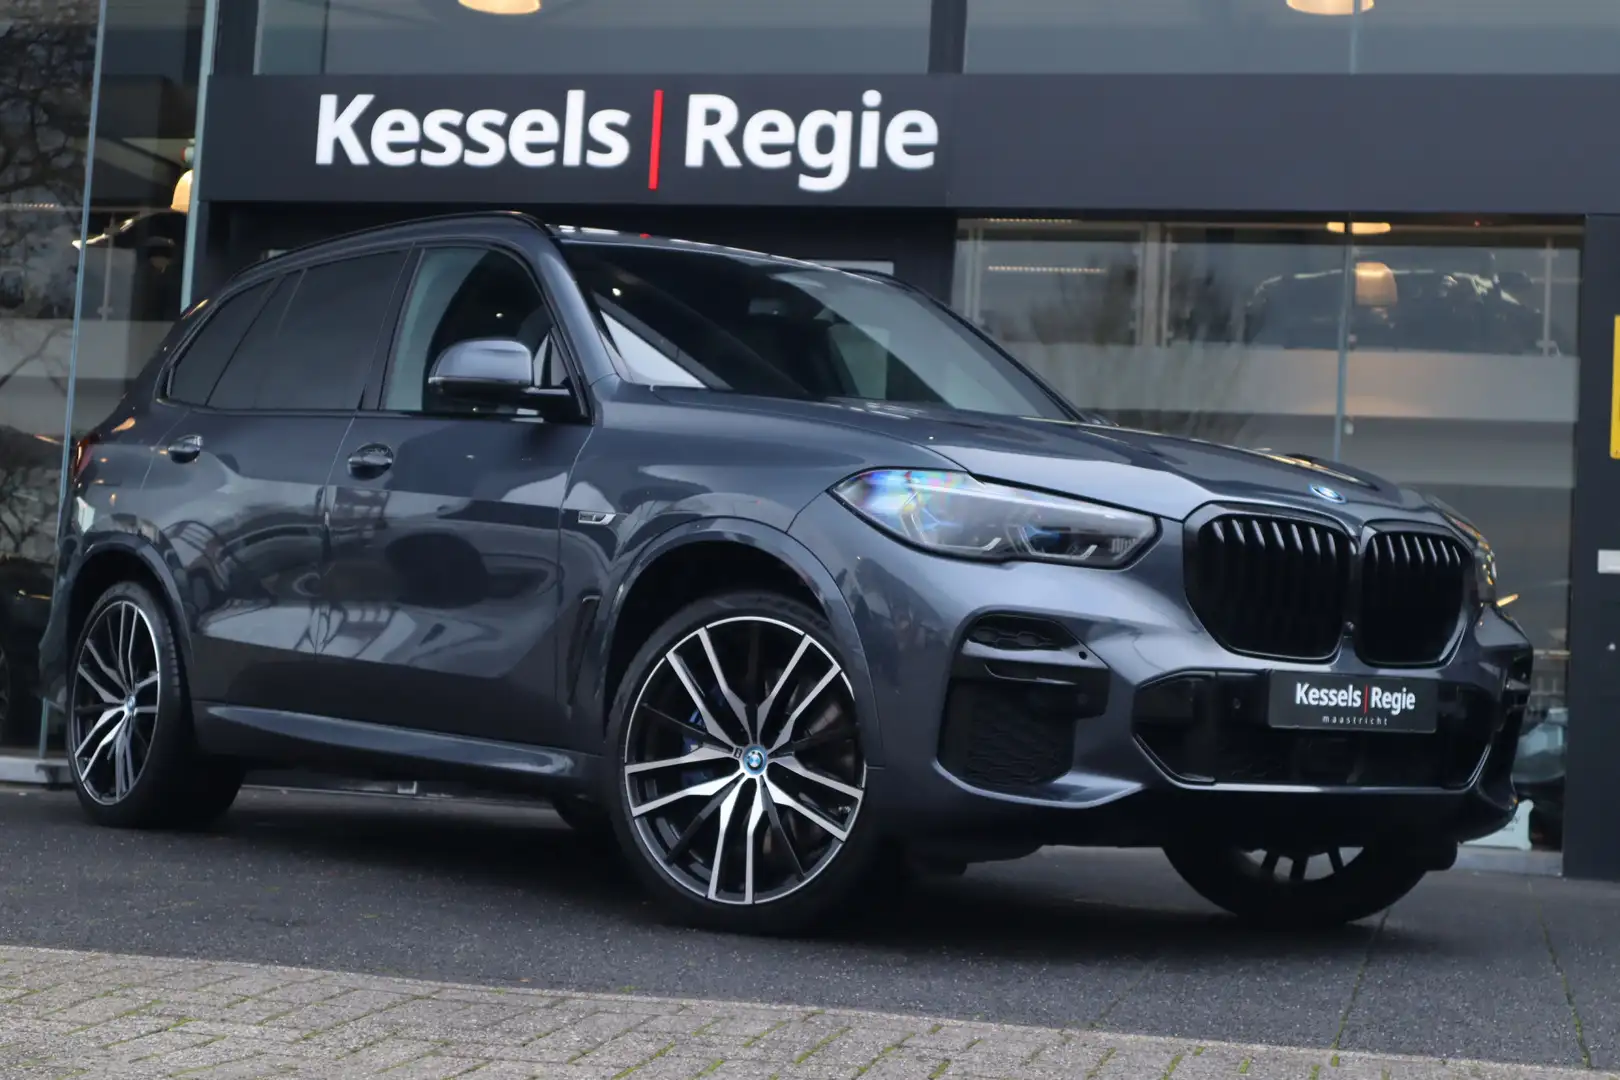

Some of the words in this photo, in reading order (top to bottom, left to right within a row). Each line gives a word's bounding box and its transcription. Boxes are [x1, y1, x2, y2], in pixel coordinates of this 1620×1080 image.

[315, 89, 631, 168] Kessels
[684, 89, 939, 192] Regie
[1295, 682, 1362, 707] Kessels
[1370, 686, 1416, 716] Regie
[1322, 715, 1388, 726] maastricht
